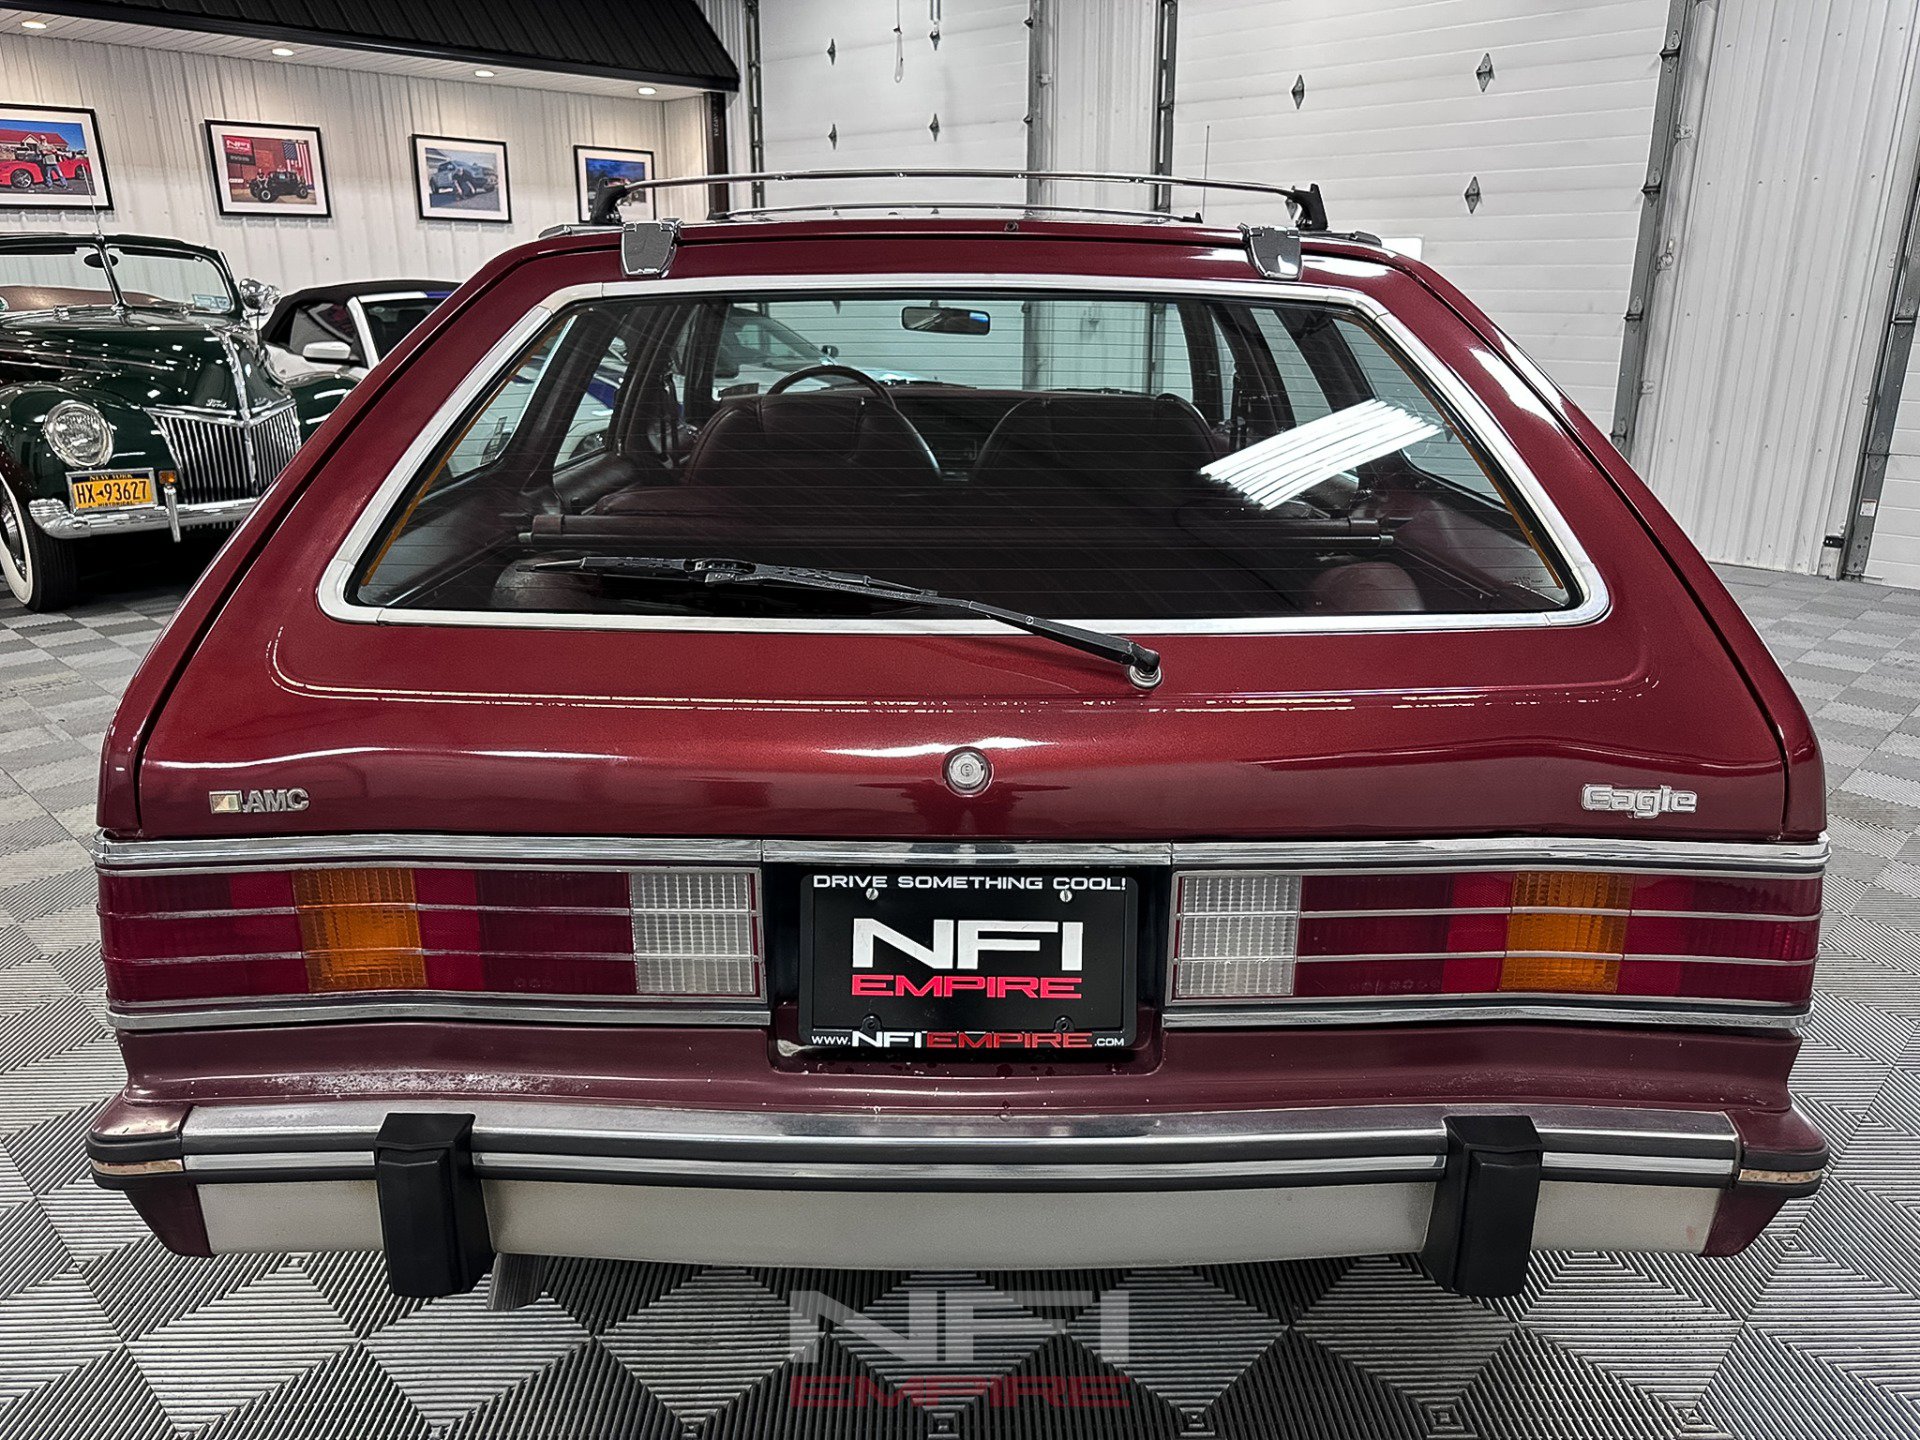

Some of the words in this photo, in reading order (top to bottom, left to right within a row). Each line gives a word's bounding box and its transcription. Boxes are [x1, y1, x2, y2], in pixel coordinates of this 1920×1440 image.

[90, 474, 110, 482] NEW
[244, 788, 310, 813] AMC
[1581, 784, 1698, 818] Eagle
[813, 876, 888, 888] DRIVE
[898, 876, 1042, 890] SOMETHING
[1053, 877, 1126, 891] COOL!
[852, 918, 1084, 972] NFI
[852, 974, 1083, 1000] EMPIRE
